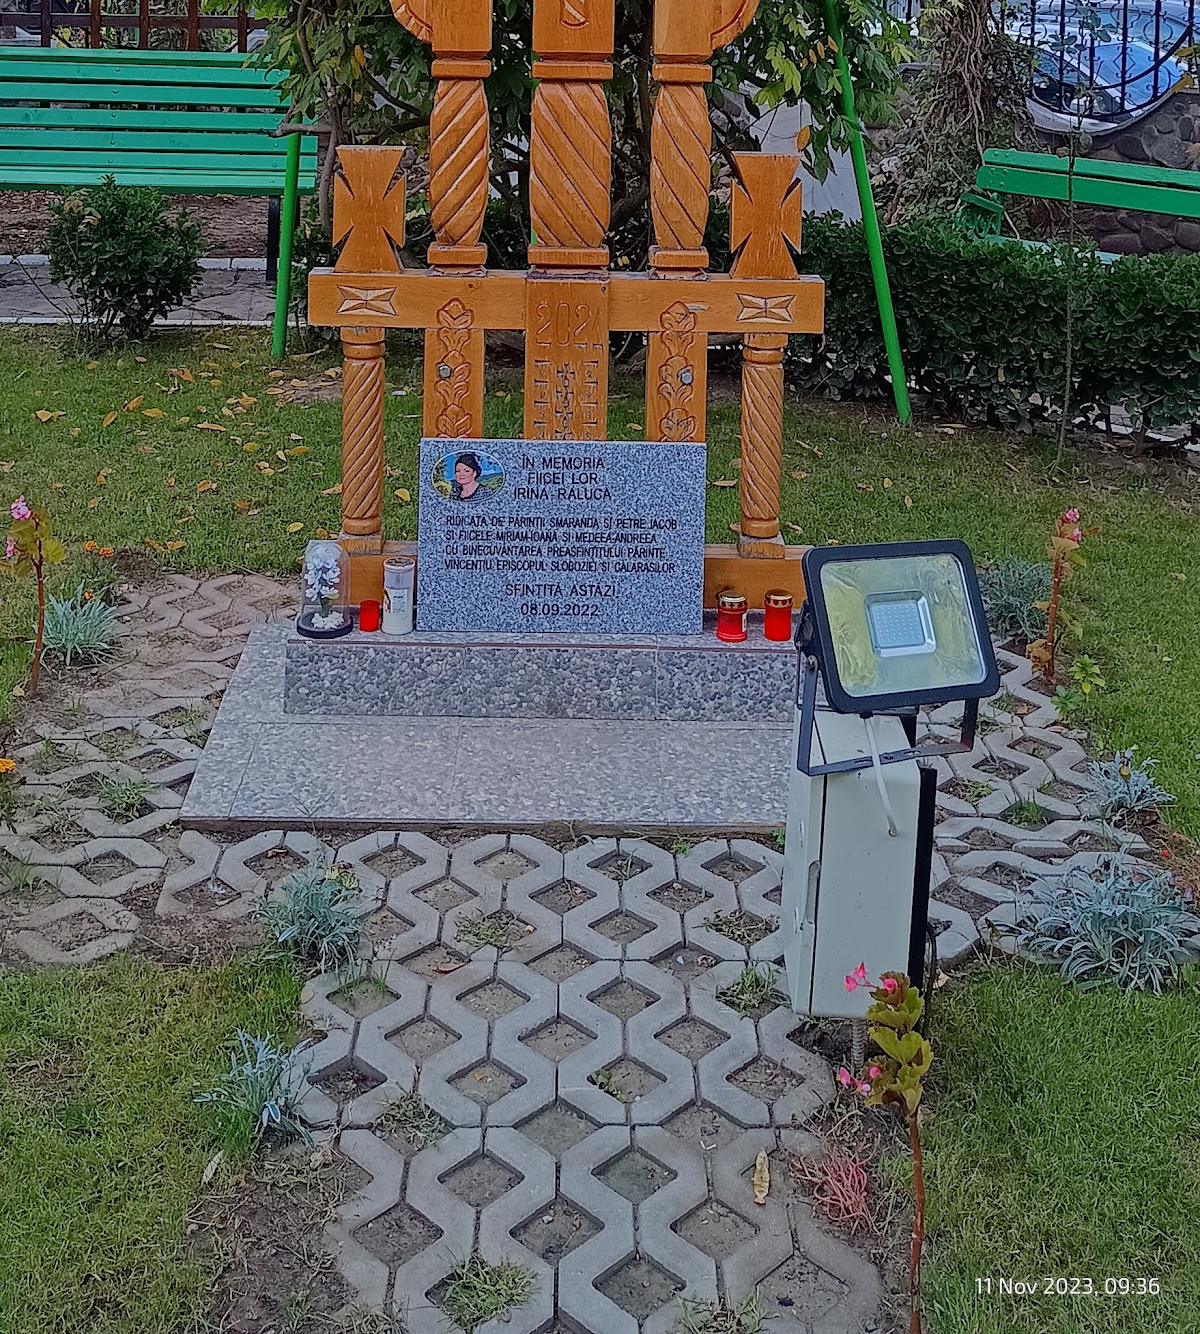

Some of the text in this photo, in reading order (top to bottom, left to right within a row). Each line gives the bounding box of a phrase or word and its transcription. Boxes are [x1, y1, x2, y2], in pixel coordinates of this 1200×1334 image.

[542, 456, 605, 470] MEMORIA
[527, 471, 599, 485] FIICEI LOR
[491, 516, 504, 527] DE
[549, 517, 599, 529] SMARANDA
[616, 518, 646, 529] PETRE
[445, 545, 459, 556] CU
[496, 560, 546, 572] EPISCOPUL
[520, 603, 600, 617] 08.09.2022
